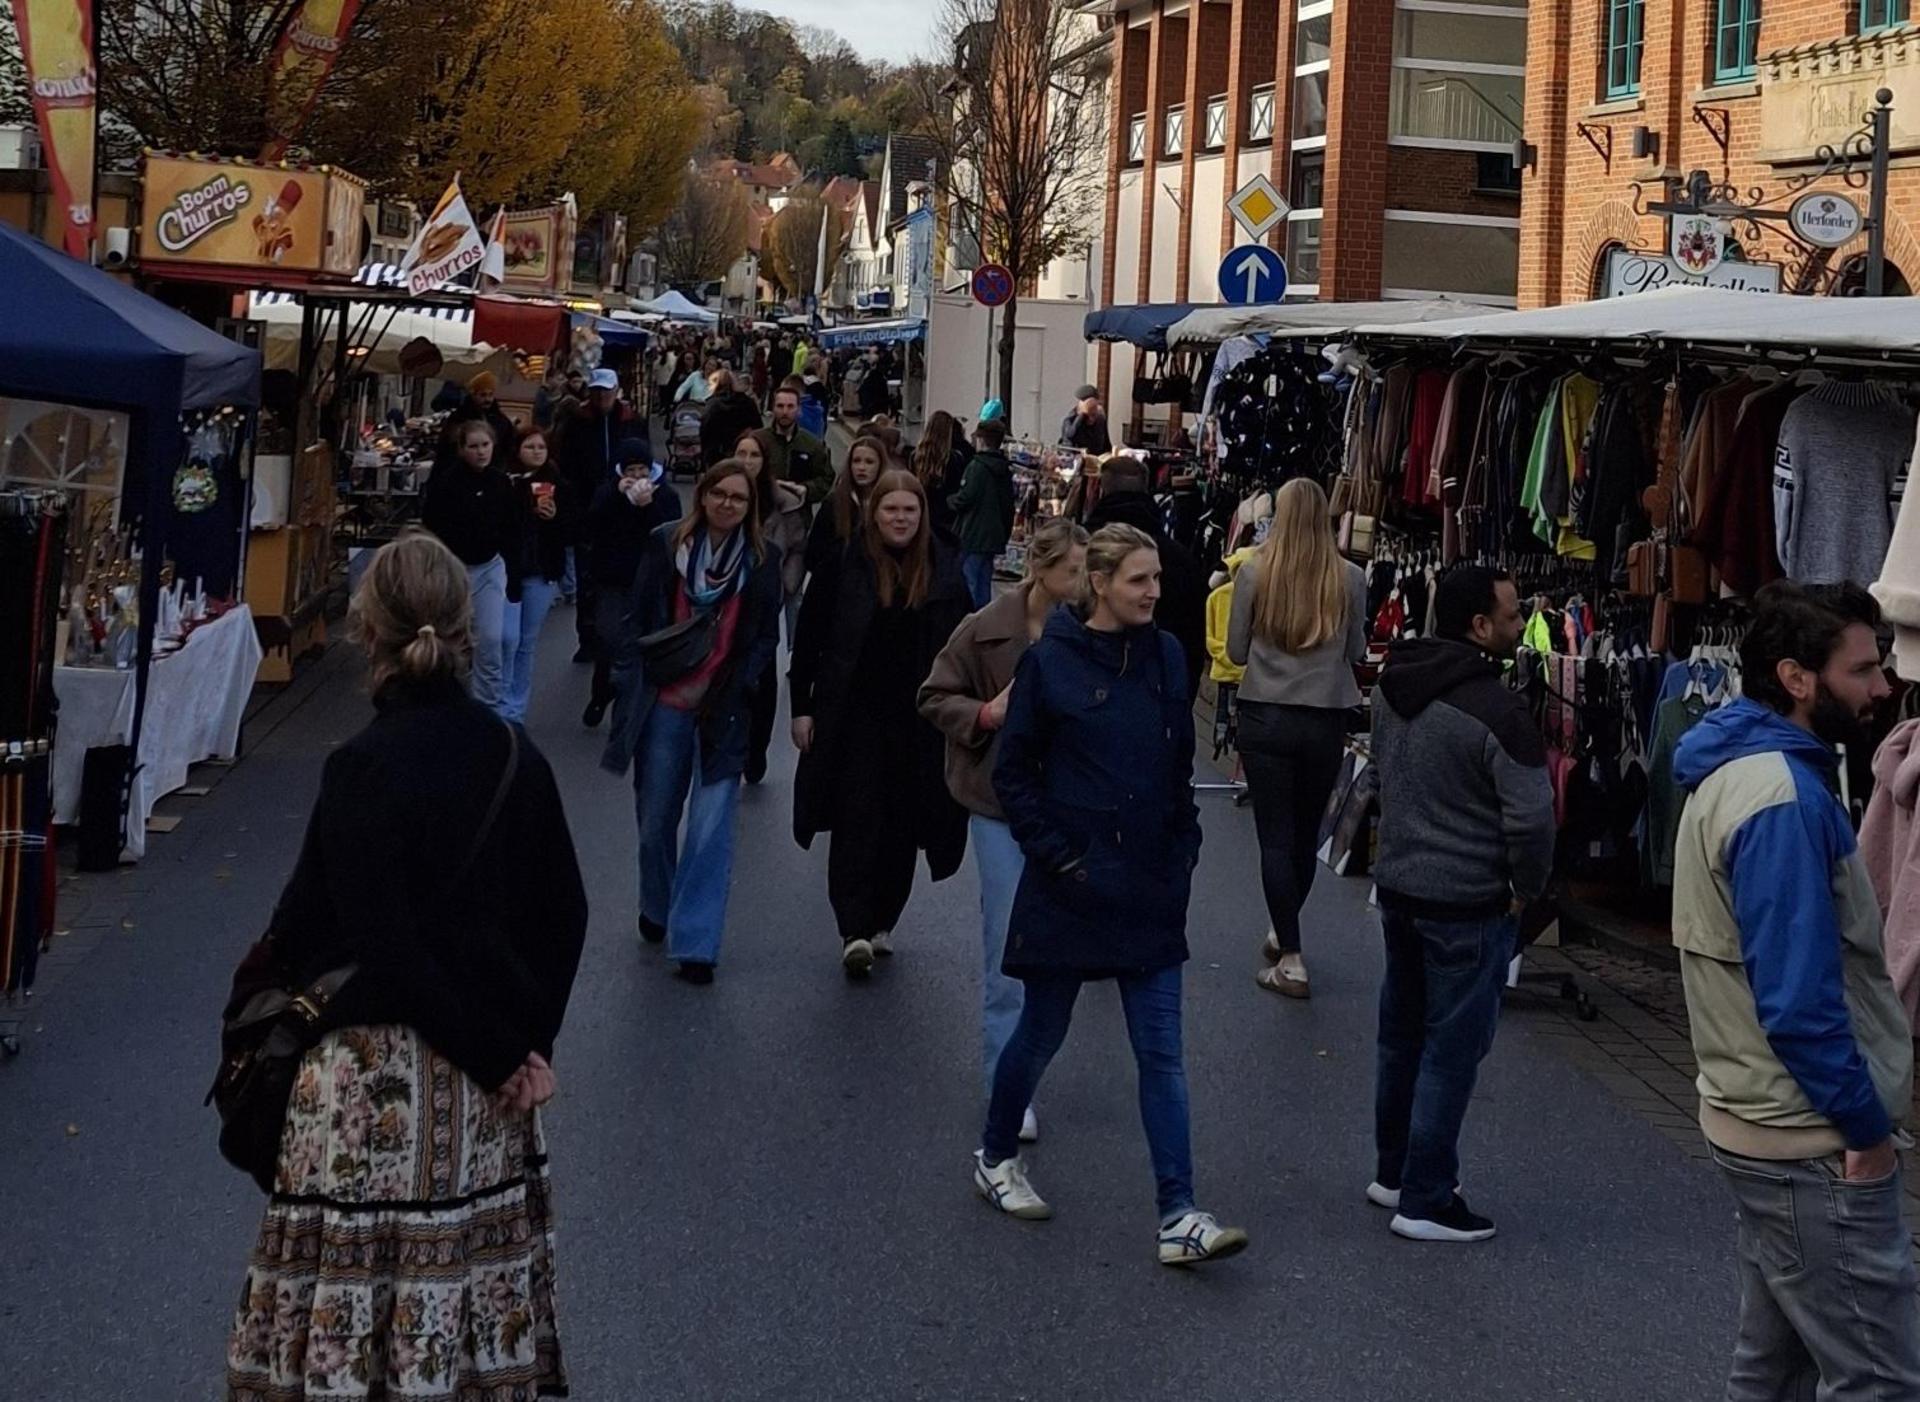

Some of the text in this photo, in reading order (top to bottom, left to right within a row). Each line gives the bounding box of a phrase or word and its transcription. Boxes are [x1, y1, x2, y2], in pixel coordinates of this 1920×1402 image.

[178, 176, 229, 213] Boom
[158, 185, 249, 250] Churros
[1803, 211, 1854, 229] Herforder
[411, 244, 483, 292] Churros
